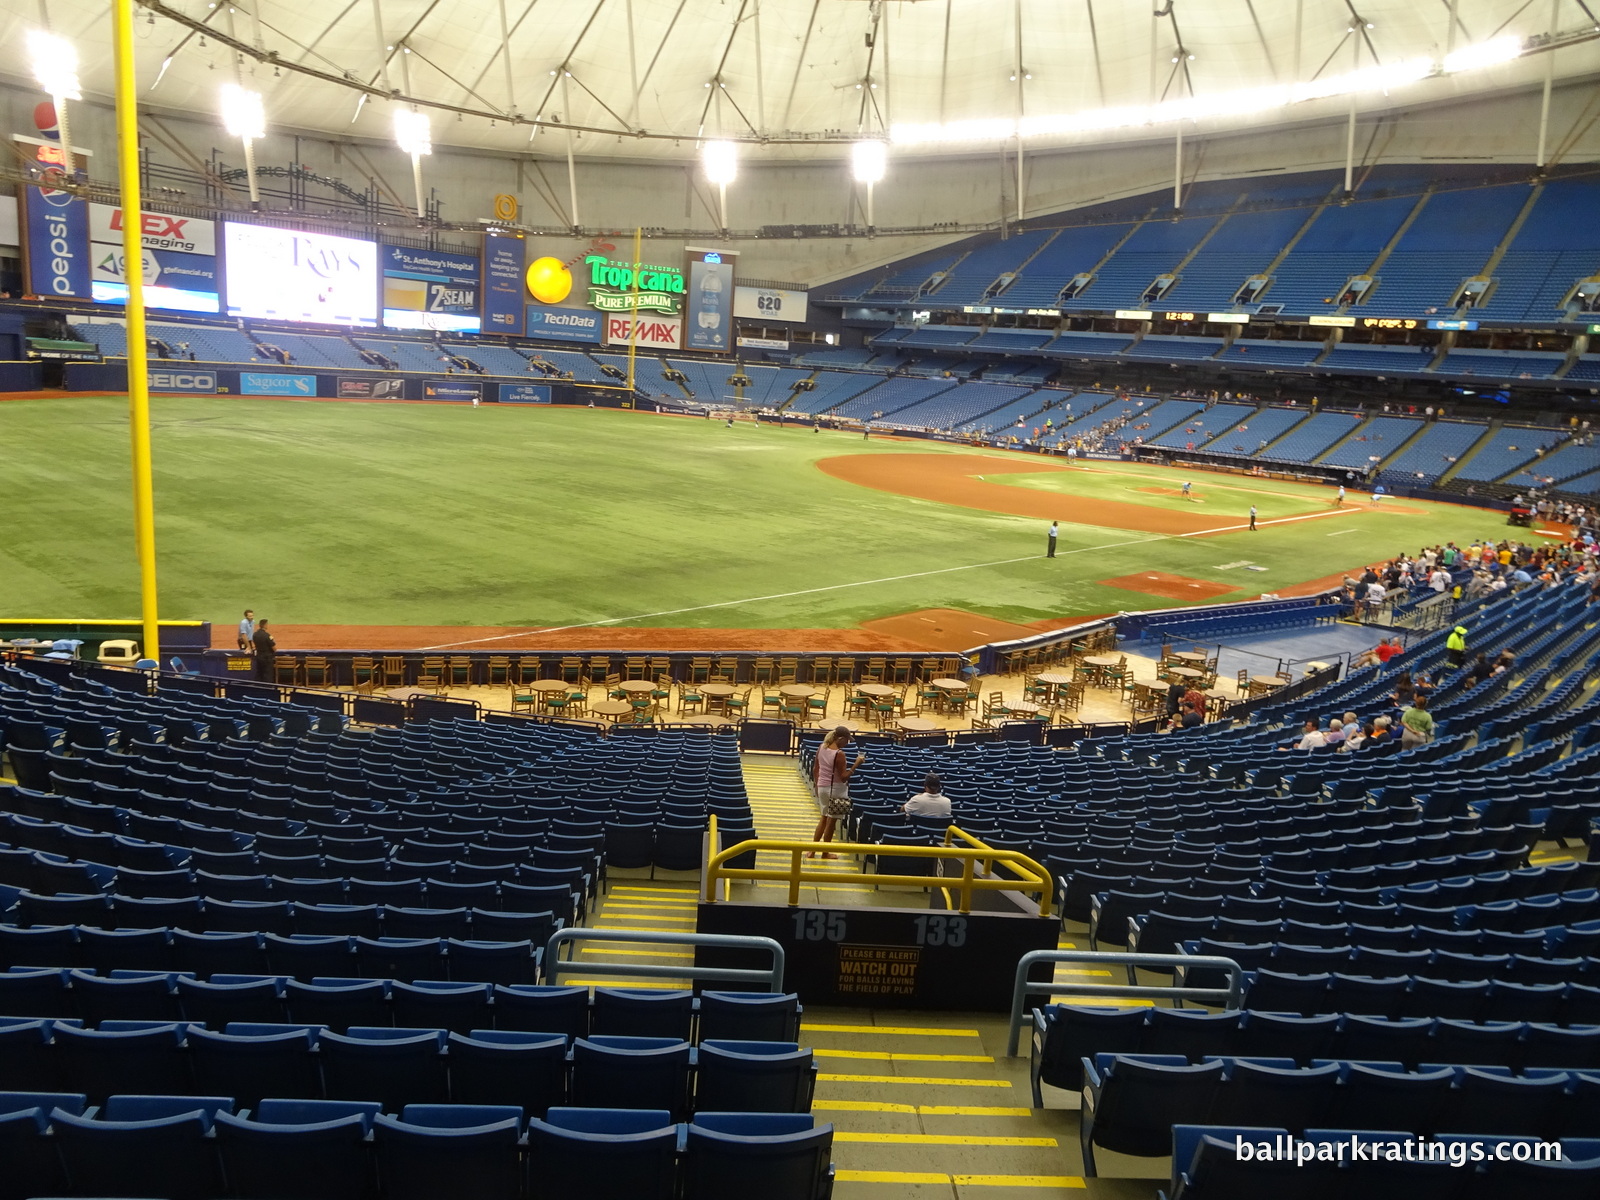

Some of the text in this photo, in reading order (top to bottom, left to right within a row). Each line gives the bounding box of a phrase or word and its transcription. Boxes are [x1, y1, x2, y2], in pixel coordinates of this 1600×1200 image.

[44, 214, 76, 296] pepsi
[402, 255, 474, 271] St. Anthony's Hospital
[585, 255, 684, 293] Tropicana
[595, 294, 623, 308] PURE
[757, 296, 782, 311] 620
[609, 319, 676, 343] RE/MAX
[248, 374, 291, 390] Sagicor
[791, 910, 847, 942] 135
[913, 915, 968, 948] 133
[843, 949, 917, 960] PLEASE BE ALERT!
[840, 961, 918, 977] WATCH OUT
[839, 975, 915, 985] FOR BALLS LEAVING
[838, 984, 914, 994] THE FIELD OF PLAY
